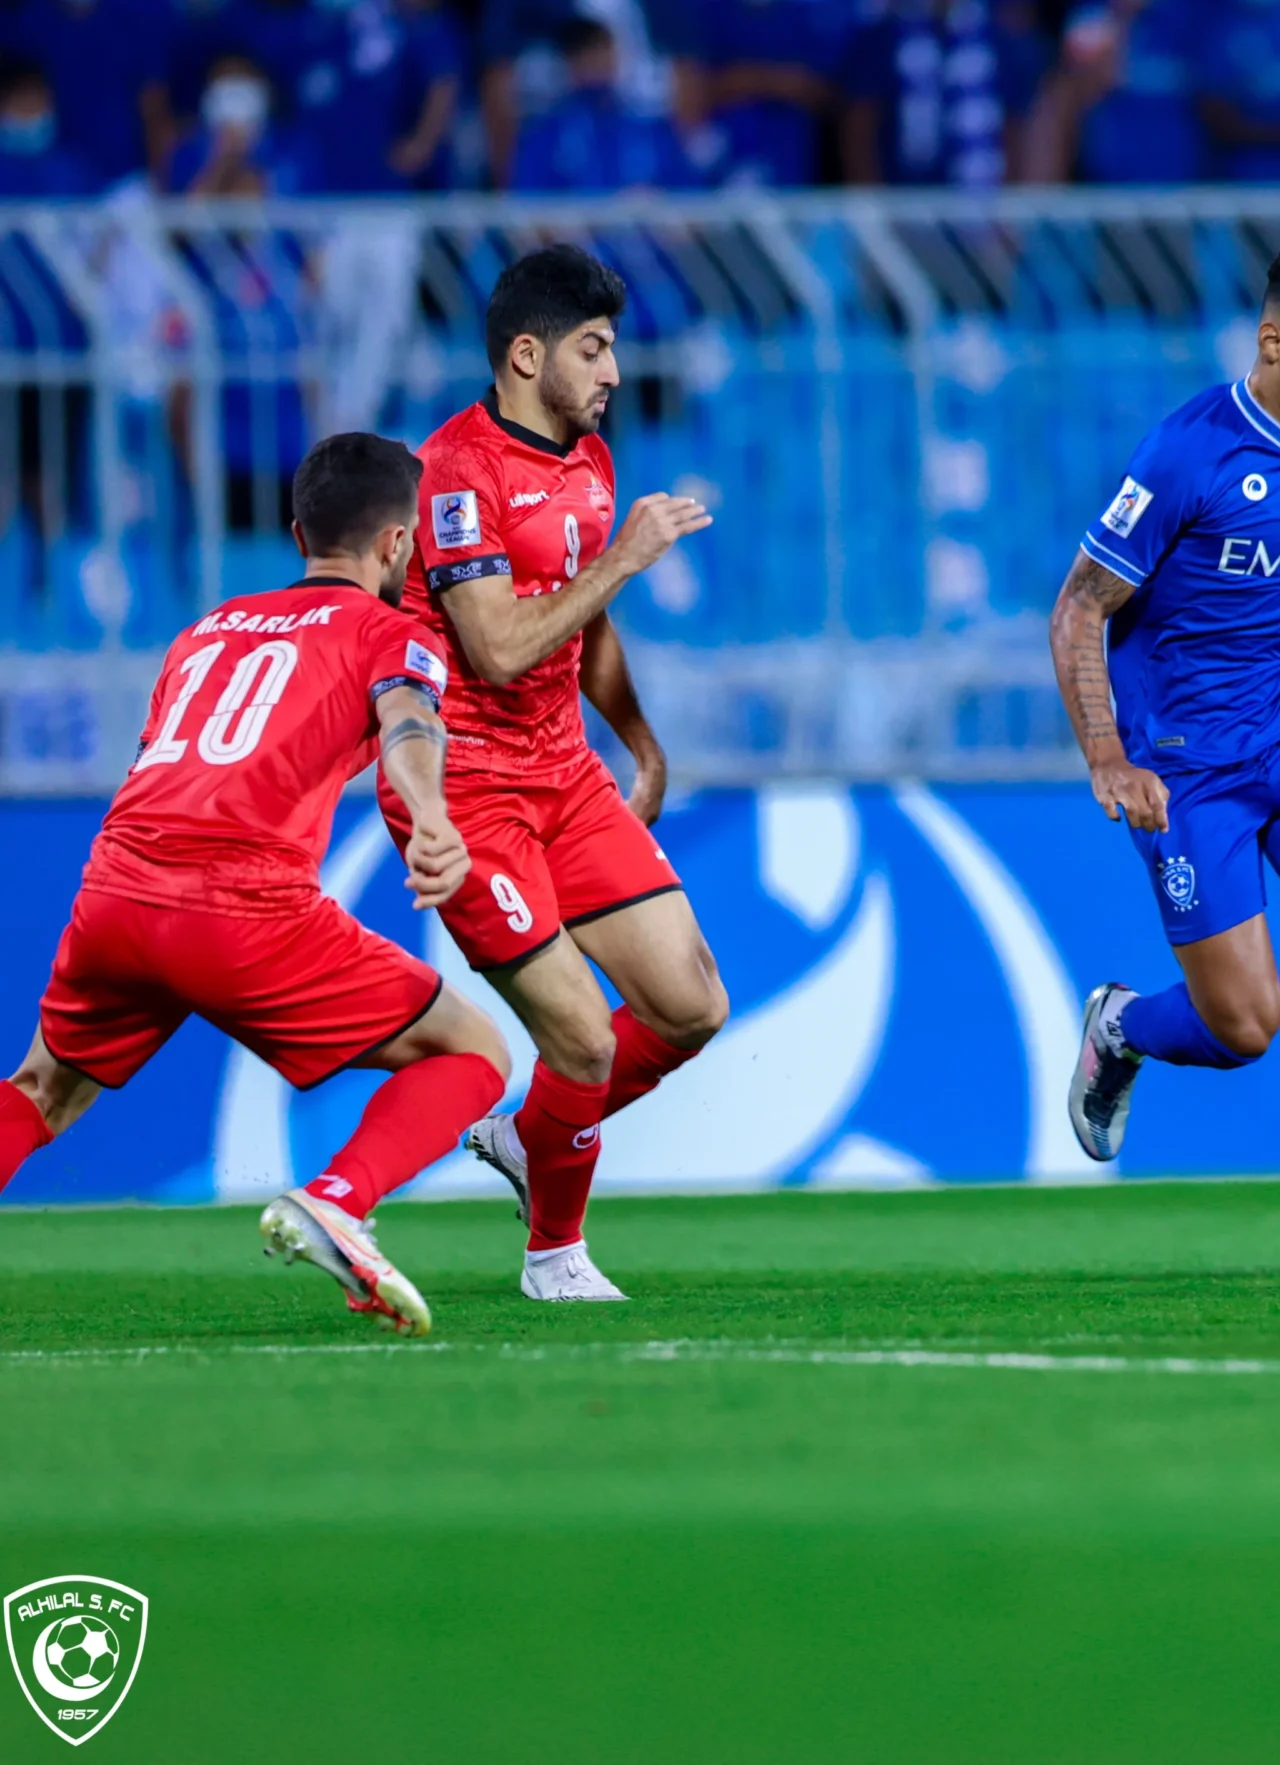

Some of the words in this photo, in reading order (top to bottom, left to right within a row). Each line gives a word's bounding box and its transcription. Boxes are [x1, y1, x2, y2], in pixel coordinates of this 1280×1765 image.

[564, 513, 581, 579] 9
[191, 605, 343, 638] M.SARLAK
[133, 639, 298, 766] 10
[490, 873, 533, 933] 9
